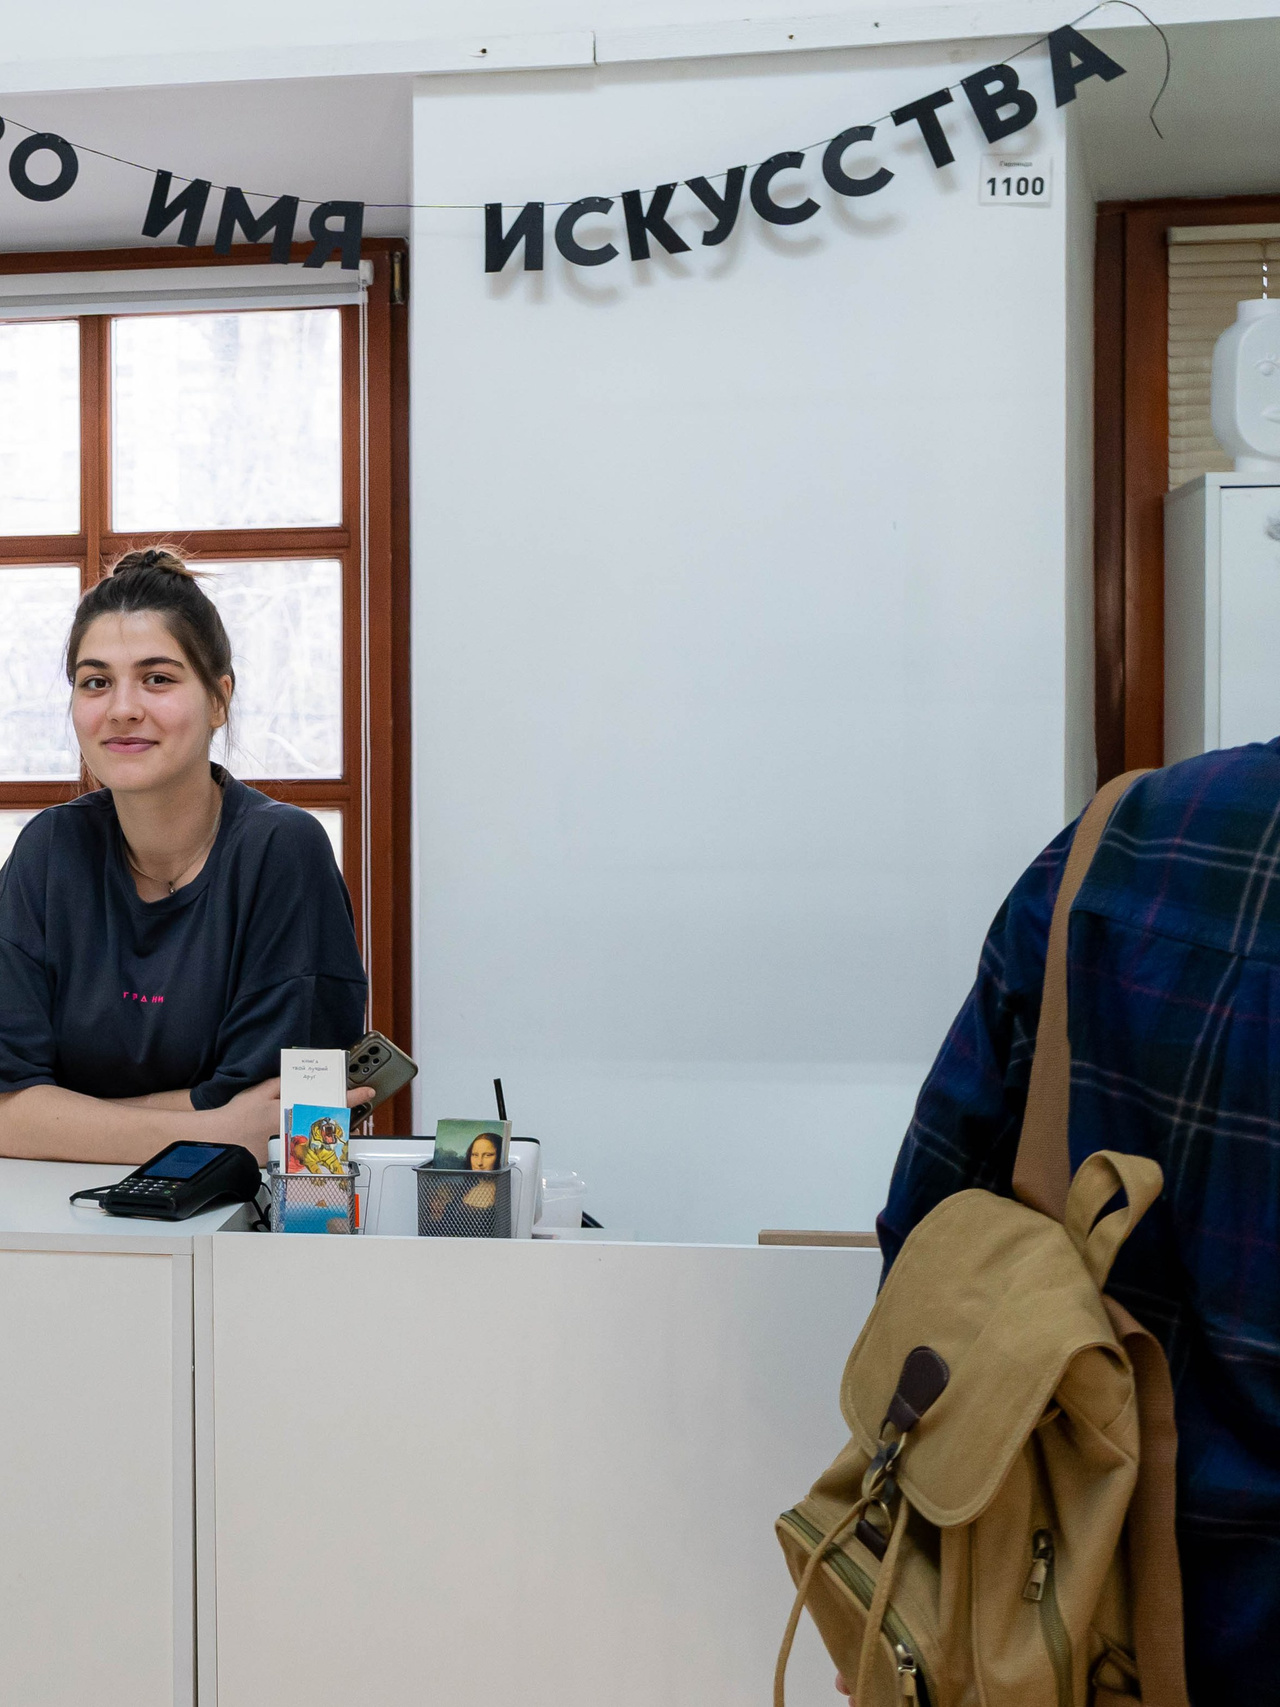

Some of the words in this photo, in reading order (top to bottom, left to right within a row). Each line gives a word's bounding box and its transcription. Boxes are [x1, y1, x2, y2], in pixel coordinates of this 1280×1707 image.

[141, 168, 365, 270] ИМЯ
[485, 24, 1127, 273] ИСКУССТВА
[987, 177, 1044, 196] 1100
